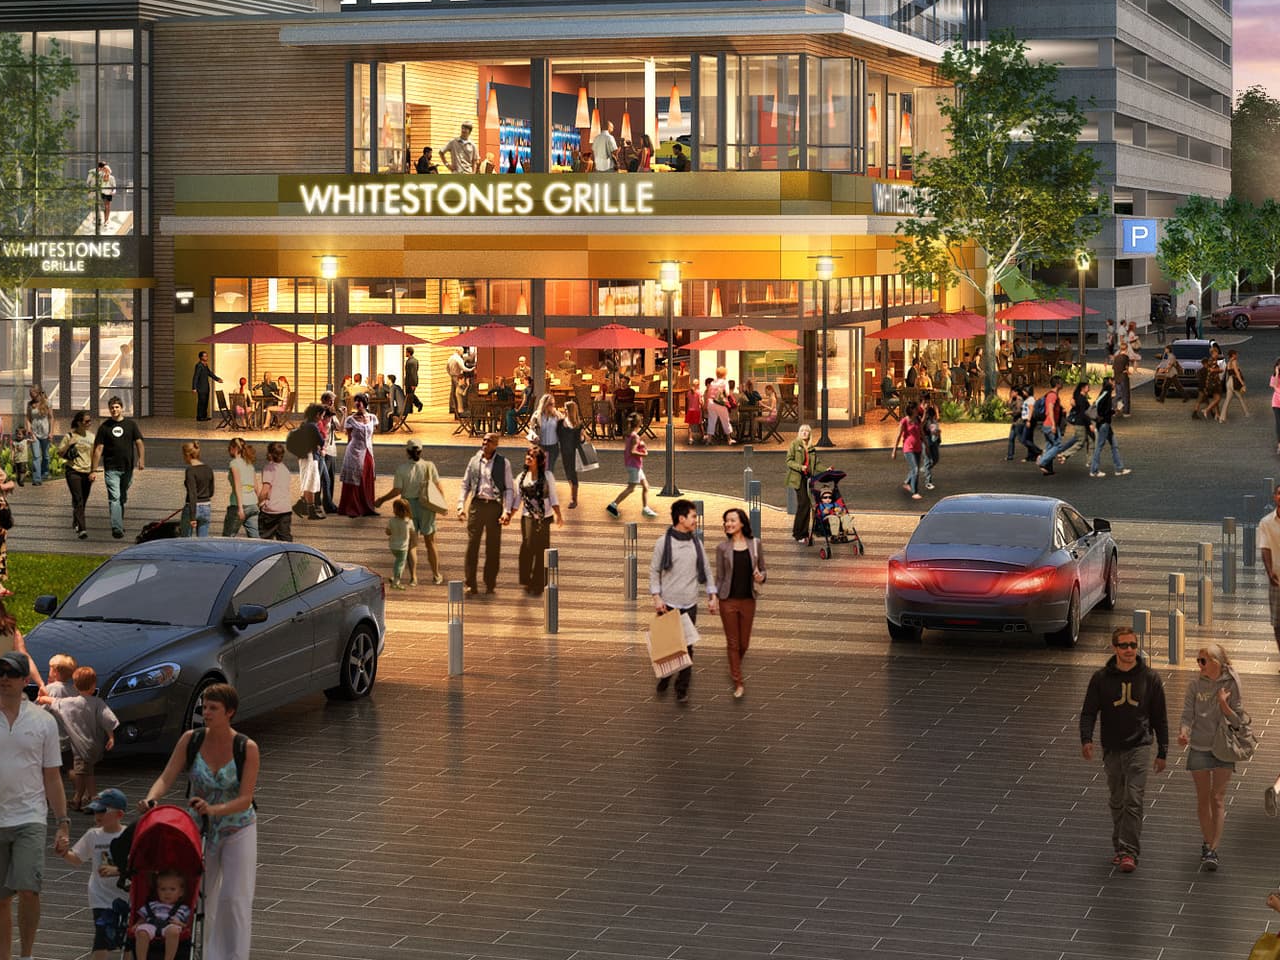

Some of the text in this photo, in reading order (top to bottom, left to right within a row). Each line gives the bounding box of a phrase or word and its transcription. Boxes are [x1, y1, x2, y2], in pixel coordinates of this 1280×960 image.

[299, 182, 654, 215] WHITESTONES GRILLE
[1132, 226, 1149, 248] P
[3, 242, 121, 258] WHITESTONES
[41, 260, 85, 272] GRILLE
